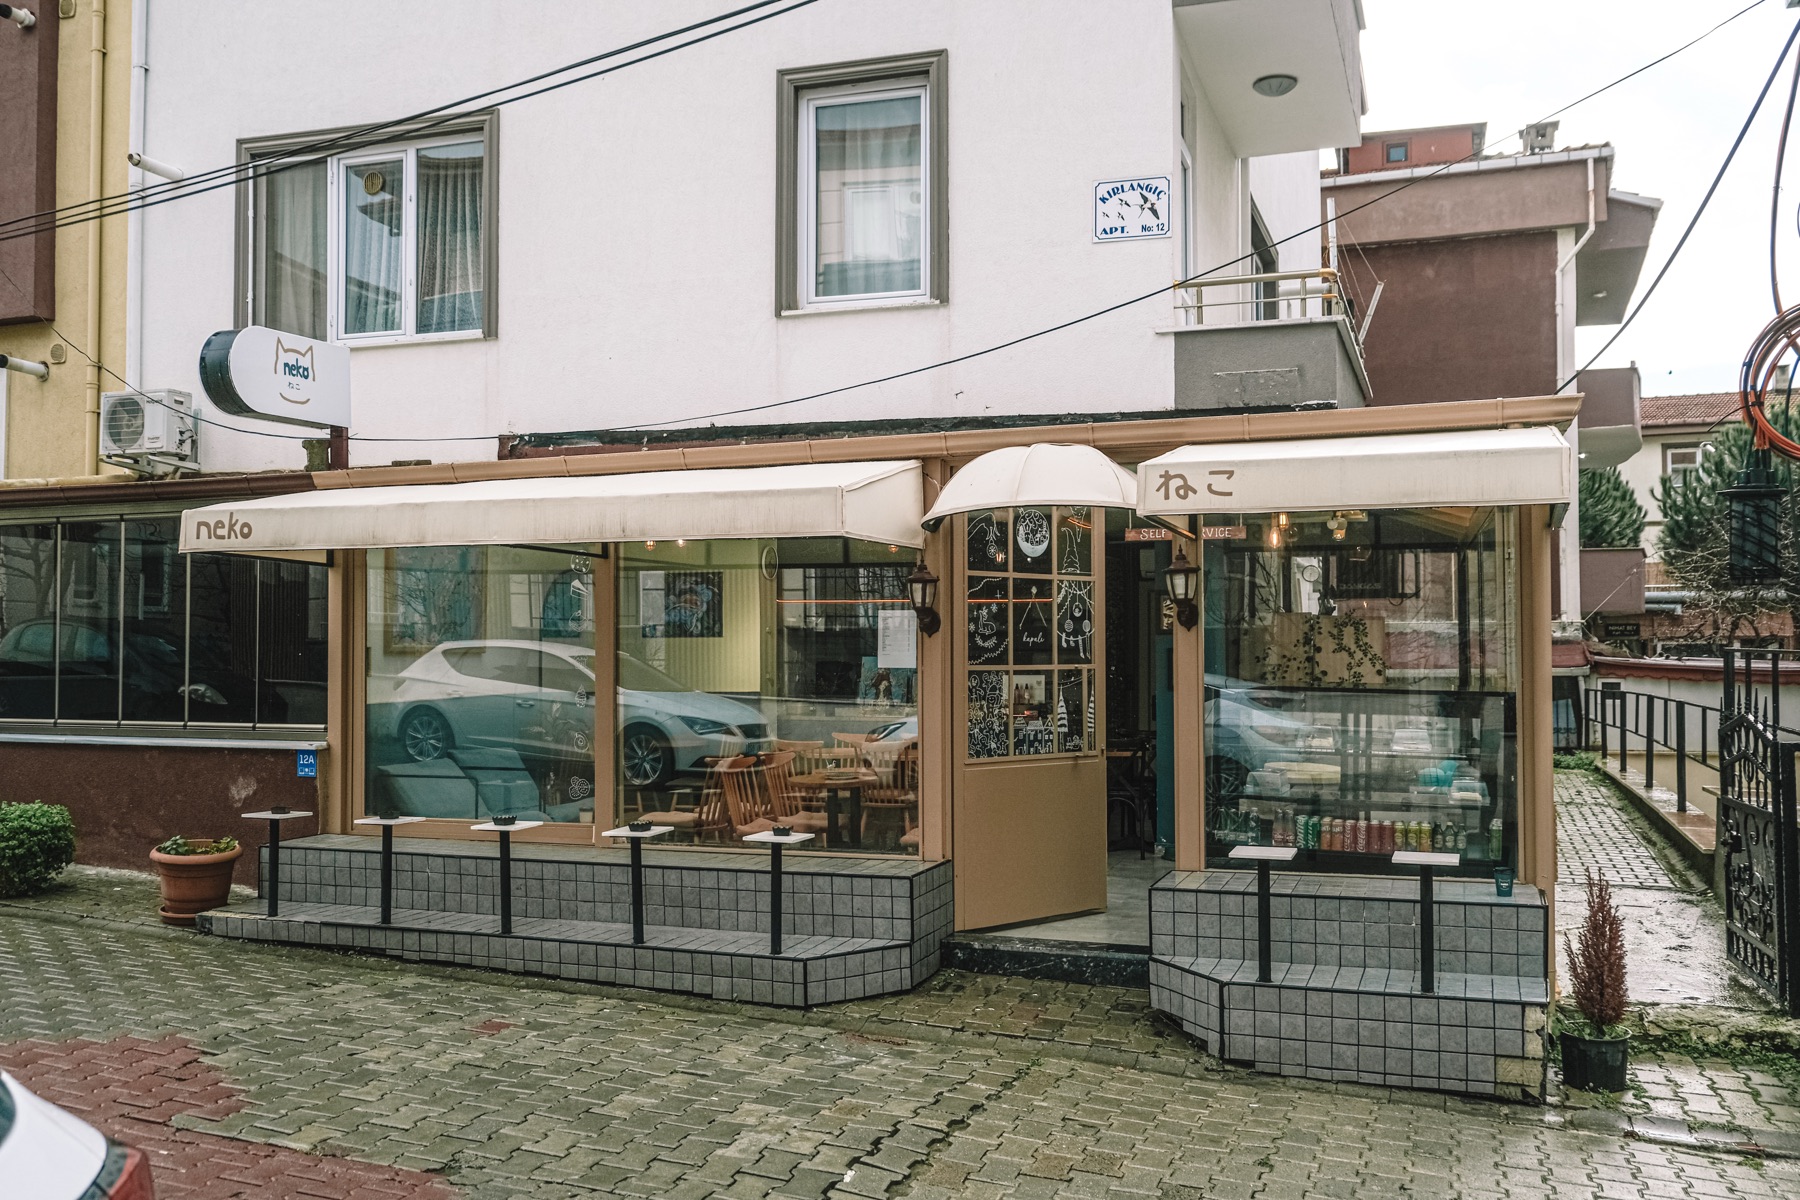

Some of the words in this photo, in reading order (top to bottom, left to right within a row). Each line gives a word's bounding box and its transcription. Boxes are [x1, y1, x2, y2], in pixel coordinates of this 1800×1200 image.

[1098, 182, 1167, 205] KIRLANGIÇ
[1100, 226, 1129, 236] APT.
[1141, 224, 1154, 233] No:
[1156, 222, 1165, 231] 12
[283, 358, 310, 380] neko
[1155, 470, 1235, 500] ねこ
[195, 511, 253, 540] neko
[1140, 528, 1168, 540] SELF
[1202, 527, 1232, 538] RVICE
[299, 754, 315, 764] 12A
